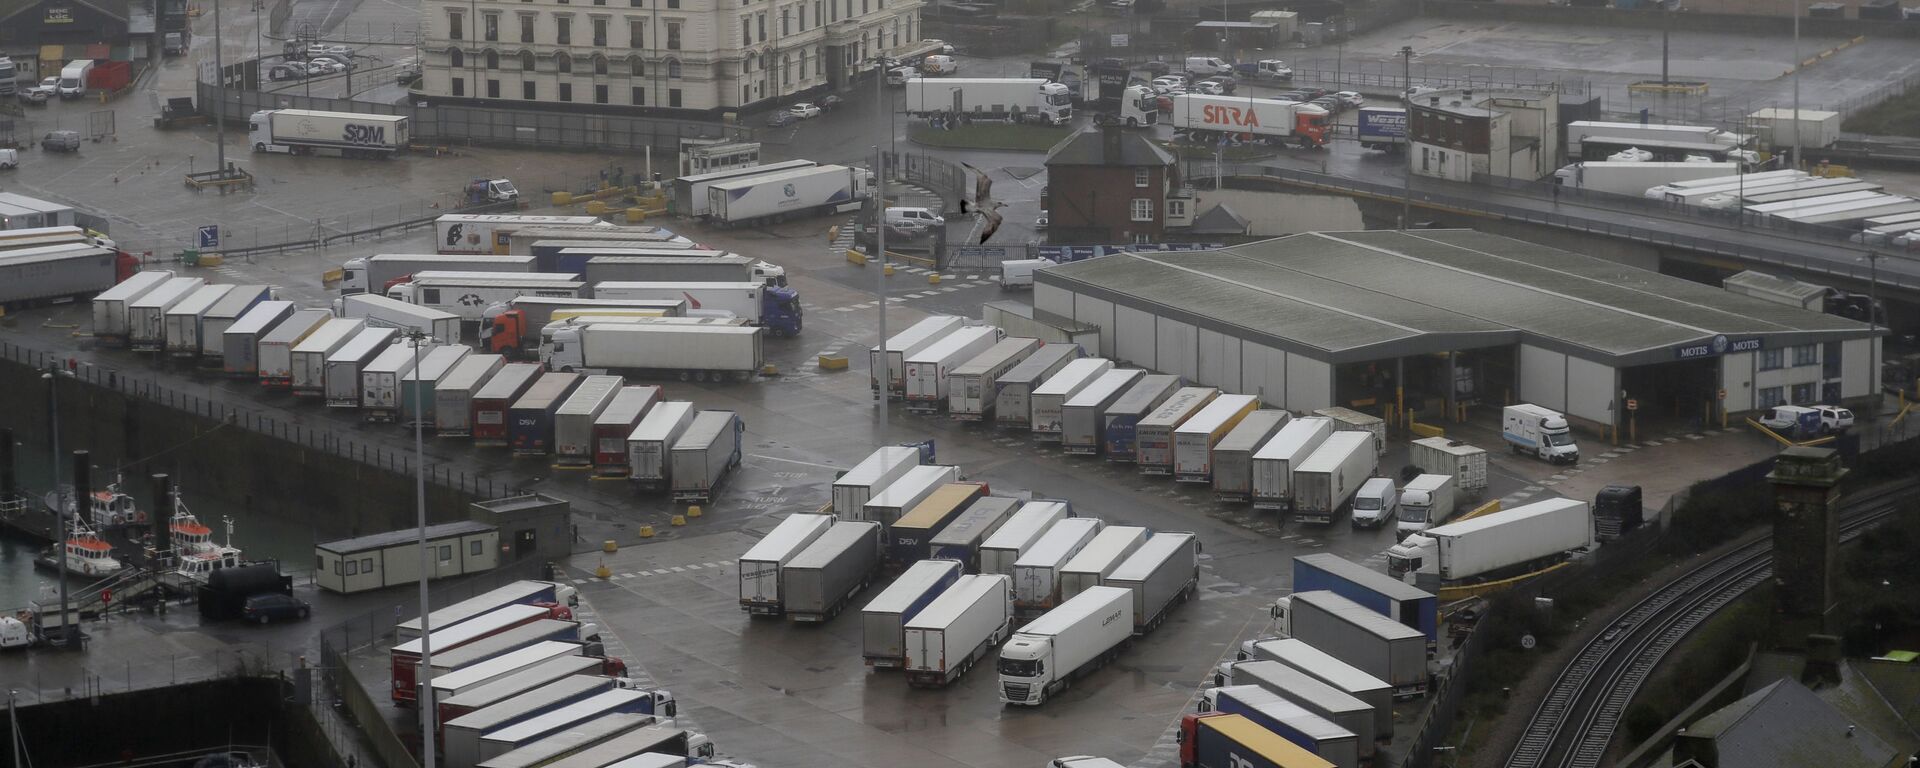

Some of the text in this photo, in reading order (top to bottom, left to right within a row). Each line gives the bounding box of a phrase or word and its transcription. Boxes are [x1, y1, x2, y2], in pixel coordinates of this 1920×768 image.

[1203, 104, 1259, 128] SITRA
[1733, 340, 1759, 351] MOTIS
[1681, 346, 1708, 358] MOTIS
[519, 418, 536, 426] DSV
